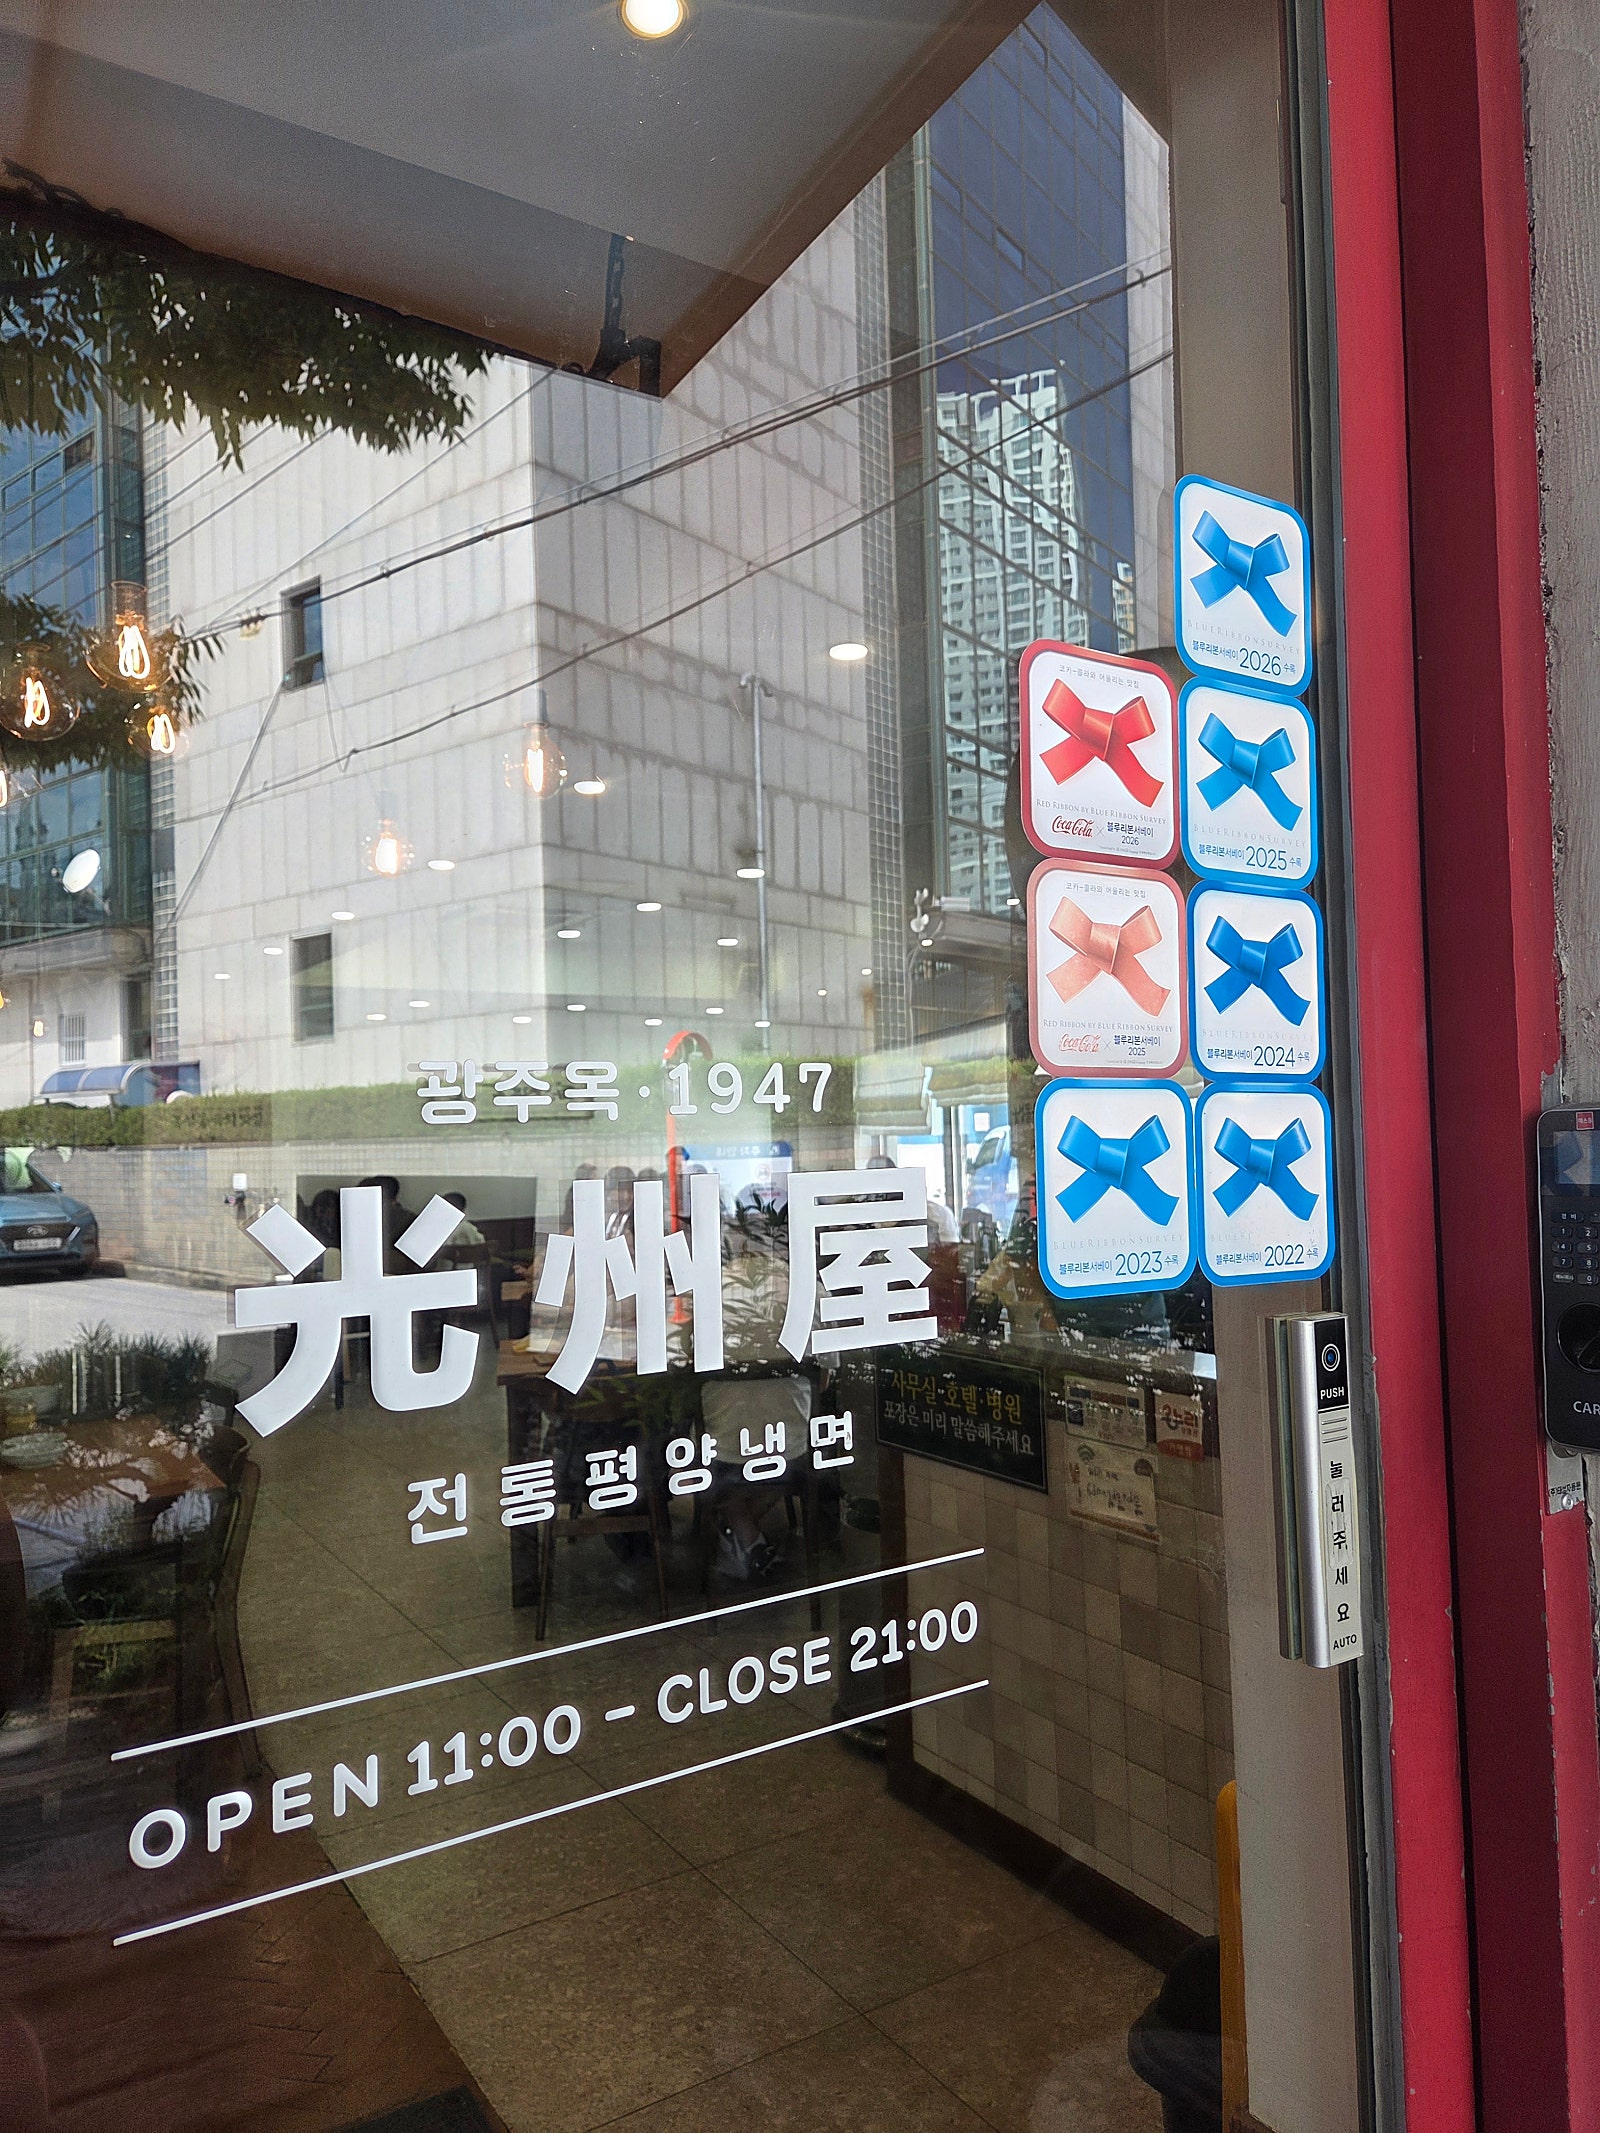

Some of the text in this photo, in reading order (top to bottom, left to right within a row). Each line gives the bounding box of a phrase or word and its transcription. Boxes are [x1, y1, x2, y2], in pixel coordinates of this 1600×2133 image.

[1192, 639, 1297, 676] 블루리본서베이 2026 수록
[1106, 821, 1154, 838] 블루리본서베이
[1121, 835, 1140, 846] 2026
[1198, 843, 1303, 871] 블루리본서베이 2025 수록
[1113, 1034, 1161, 1047] 블루리본서베이
[1128, 1046, 1146, 1057] 2025
[1206, 1045, 1311, 1068] 블루리본서베이 2024 수록
[1059, 1250, 1180, 1276] 블루리본서베이 2023 수록
[1215, 1252, 1262, 1265] 블루리본서베이
[1263, 1243, 1305, 1267] 2022
[234, 1167, 939, 1438] 光州屋
[1320, 1386, 1346, 1400] PUSH
[884, 1400, 919, 1427] 포장은
[922, 1409, 947, 1435] 미리
[1333, 1633, 1358, 1651] AUTO
[128, 1753, 380, 1869] OPEN
[406, 1703, 582, 1798] 11:00
[656, 1636, 832, 1725] CLOSE
[849, 1599, 980, 1676] 21:00
